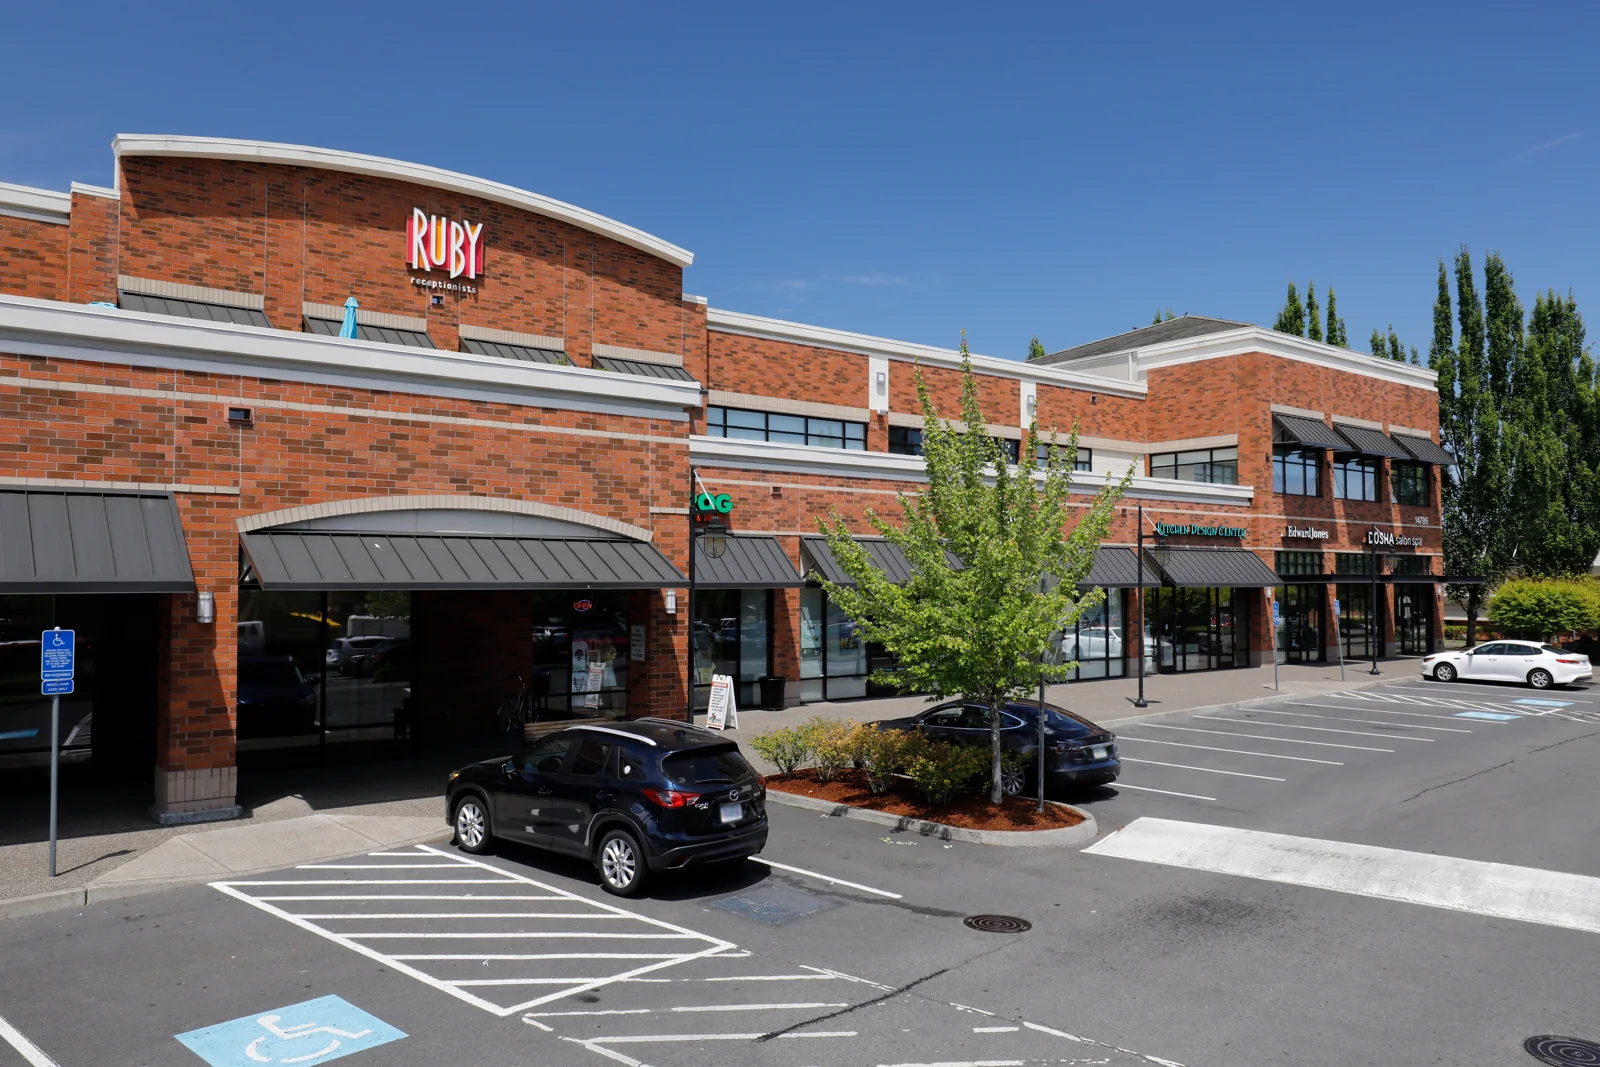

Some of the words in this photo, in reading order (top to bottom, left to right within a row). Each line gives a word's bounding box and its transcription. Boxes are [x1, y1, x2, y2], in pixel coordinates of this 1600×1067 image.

[412, 207, 483, 279] RUBY
[410, 277, 477, 293] receptionists
[691, 492, 734, 514] OG
[1191, 523, 1218, 536] DESIGN
[1218, 526, 1248, 540] CENTER
[1395, 534, 1411, 546] salon
[1412, 537, 1423, 548] spa
[573, 601, 593, 609] OPEN
